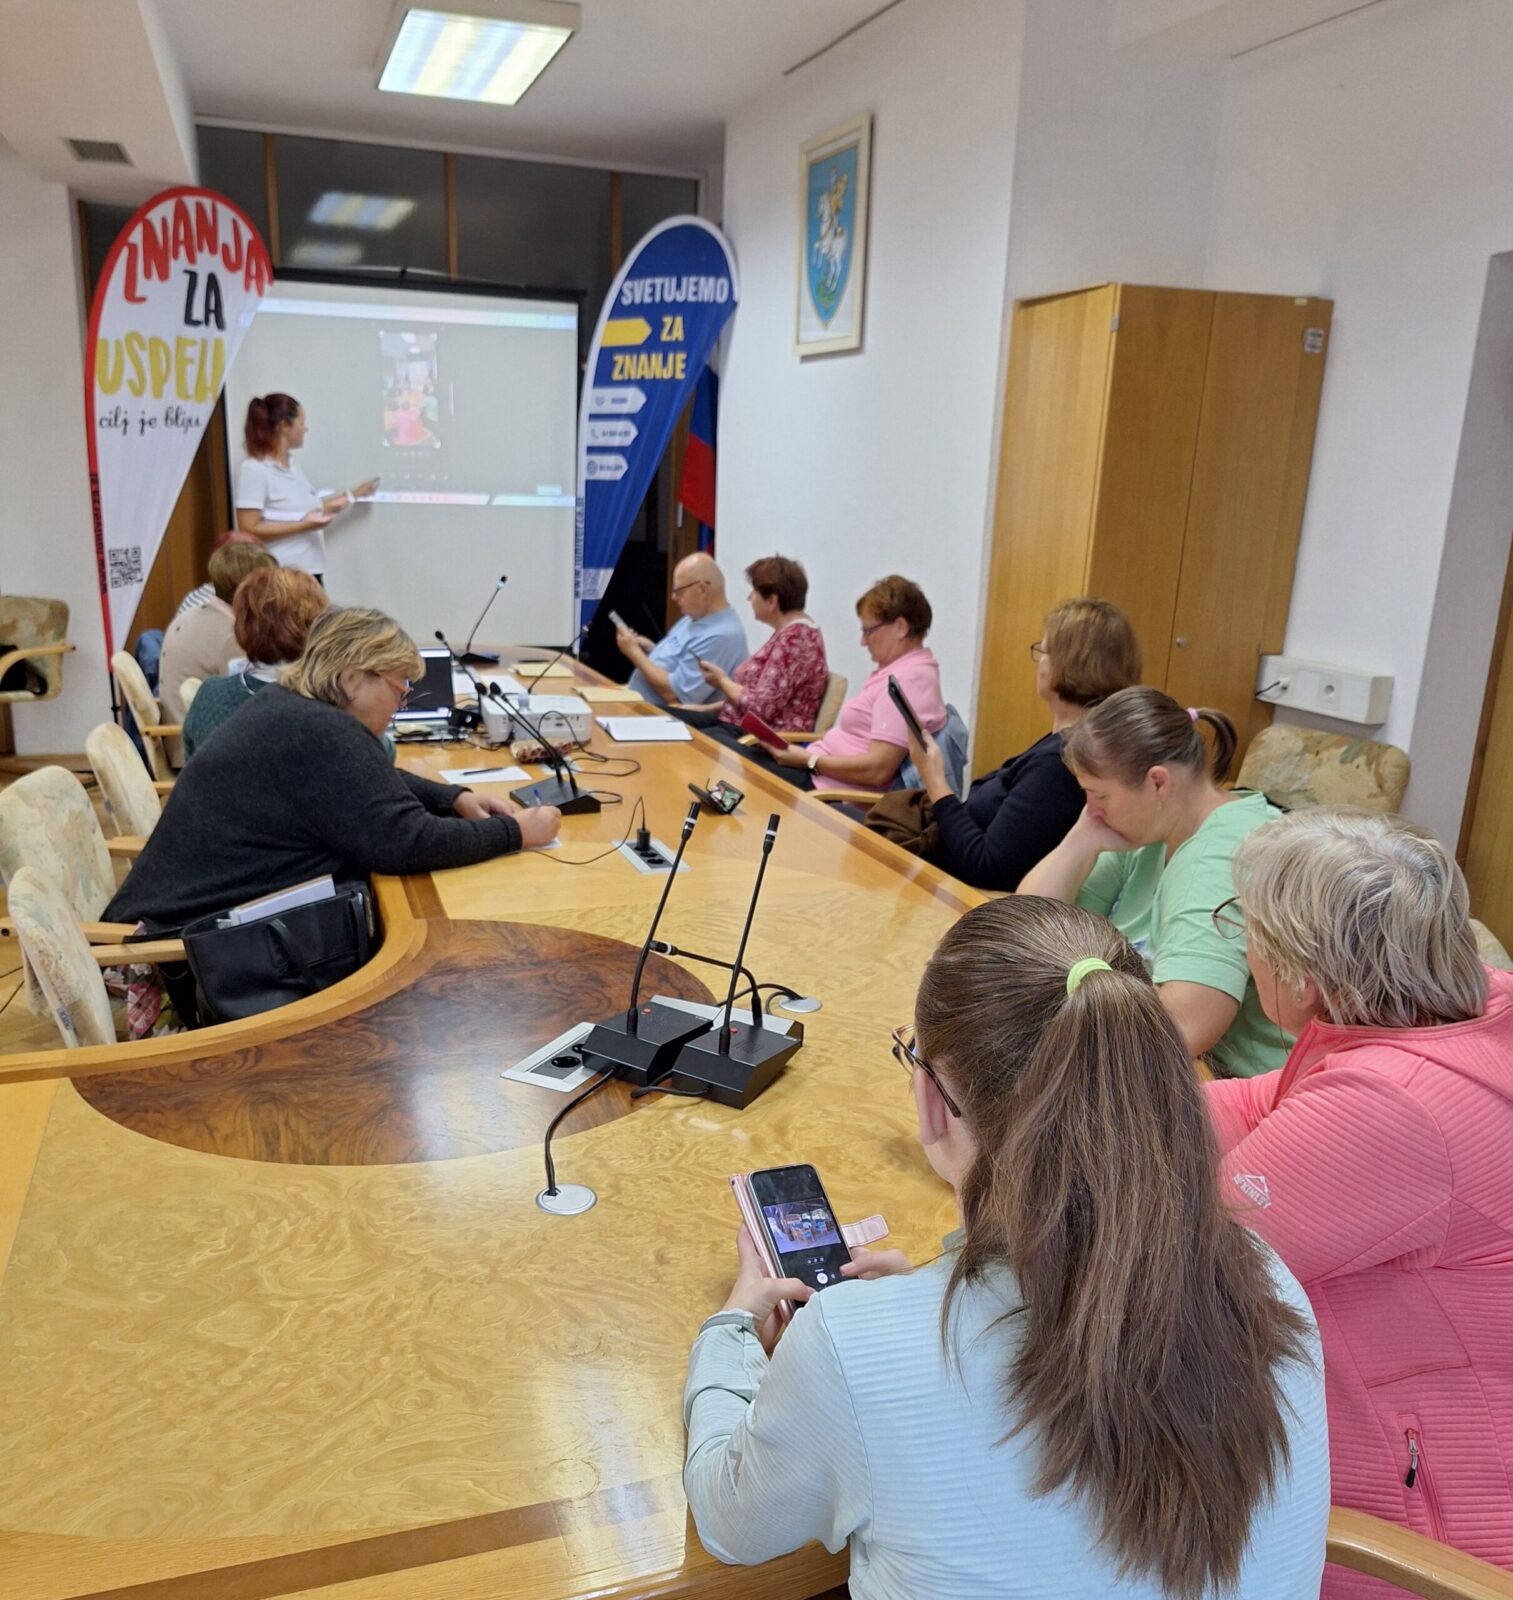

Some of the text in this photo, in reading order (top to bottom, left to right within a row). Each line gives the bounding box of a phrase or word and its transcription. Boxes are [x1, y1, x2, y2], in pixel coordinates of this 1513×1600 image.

[124, 198, 266, 304] ZNANJA
[183, 269, 226, 331] ZA
[620, 275, 730, 306] SVETUJEMO
[659, 314, 685, 342] ZA
[611, 352, 687, 381] ZNANJE
[99, 405, 129, 436] cilj
[139, 410, 157, 436] je
